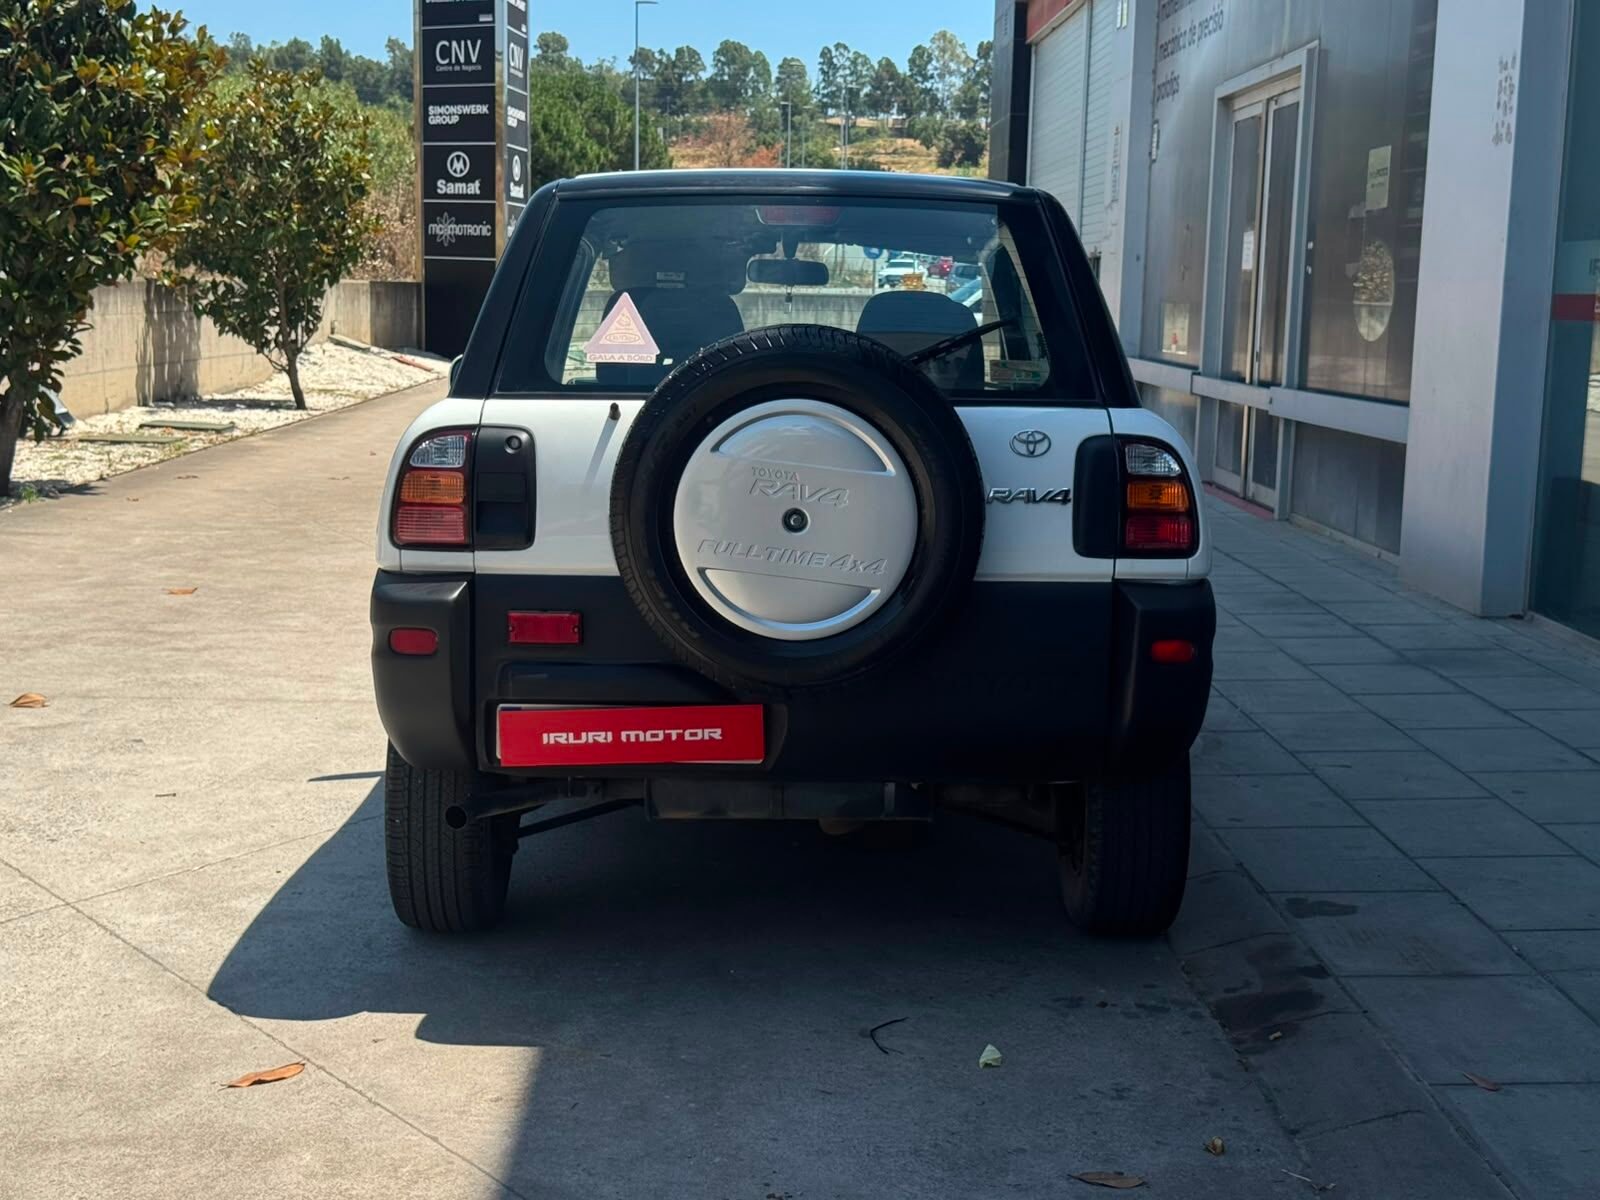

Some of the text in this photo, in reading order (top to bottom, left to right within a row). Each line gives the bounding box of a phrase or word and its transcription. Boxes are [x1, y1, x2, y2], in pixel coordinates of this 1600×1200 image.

[435, 39, 481, 65] CNV
[428, 104, 490, 116] SIMONSWERK
[428, 115, 460, 125] GROUP
[436, 179, 481, 195] Samat
[589, 354, 614, 362] GALA
[617, 354, 625, 362] A
[751, 466, 800, 481] TOYOTA
[750, 478, 850, 508] RAV4
[986, 487, 1072, 505] RAV4
[542, 728, 723, 745] IRURI MOTOR
